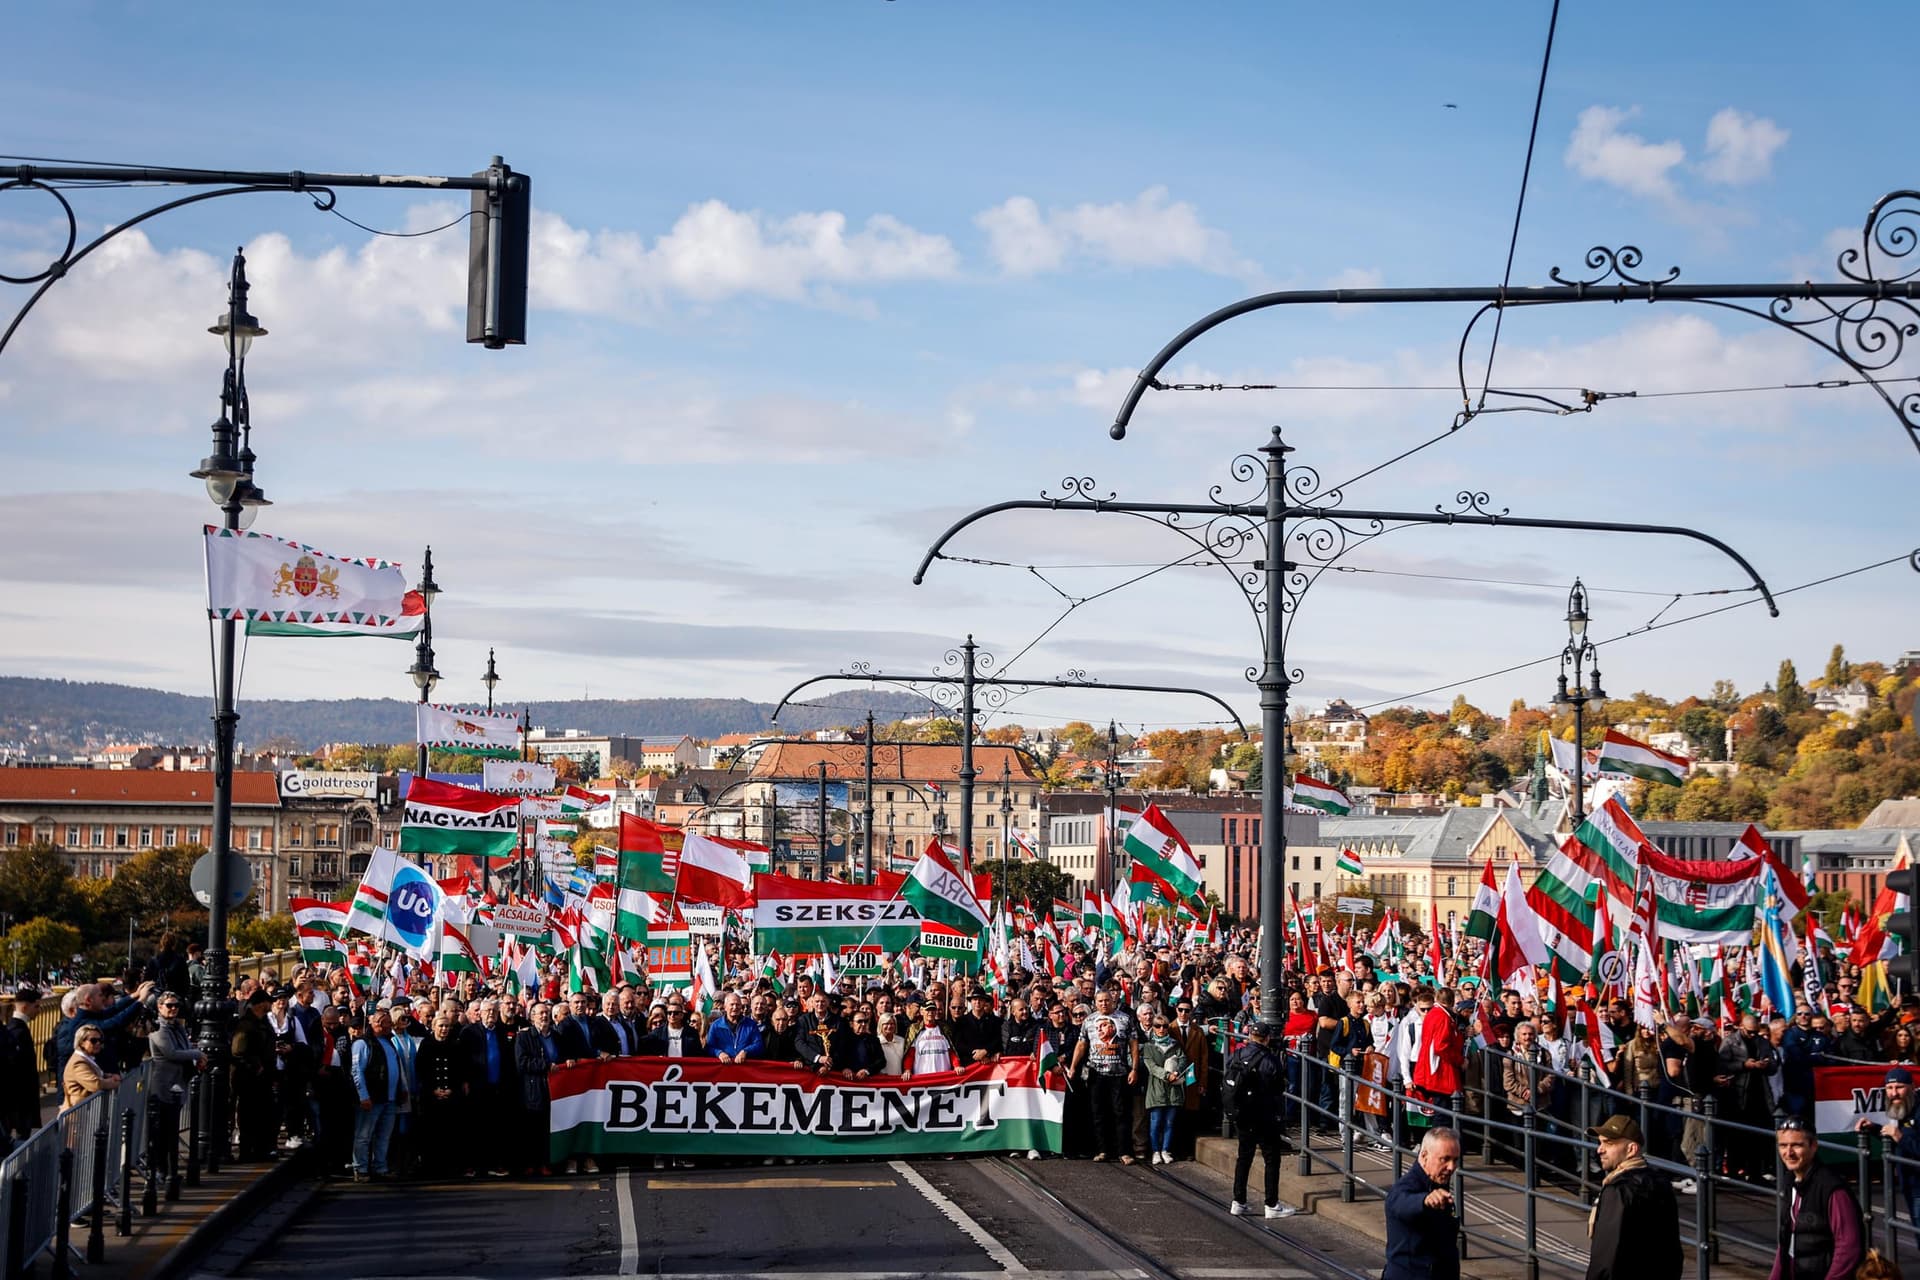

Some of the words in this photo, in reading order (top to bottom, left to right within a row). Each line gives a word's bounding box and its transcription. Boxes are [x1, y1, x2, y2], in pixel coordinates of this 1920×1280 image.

[302, 777, 375, 790] goldtresor
[403, 808, 518, 828] NAGYATÁD
[498, 908, 542, 923] ACSALAG
[776, 904, 921, 921] SZEKSZA
[925, 933, 974, 949] GARBOLC
[606, 1066, 1004, 1132] BÉKEMENET
